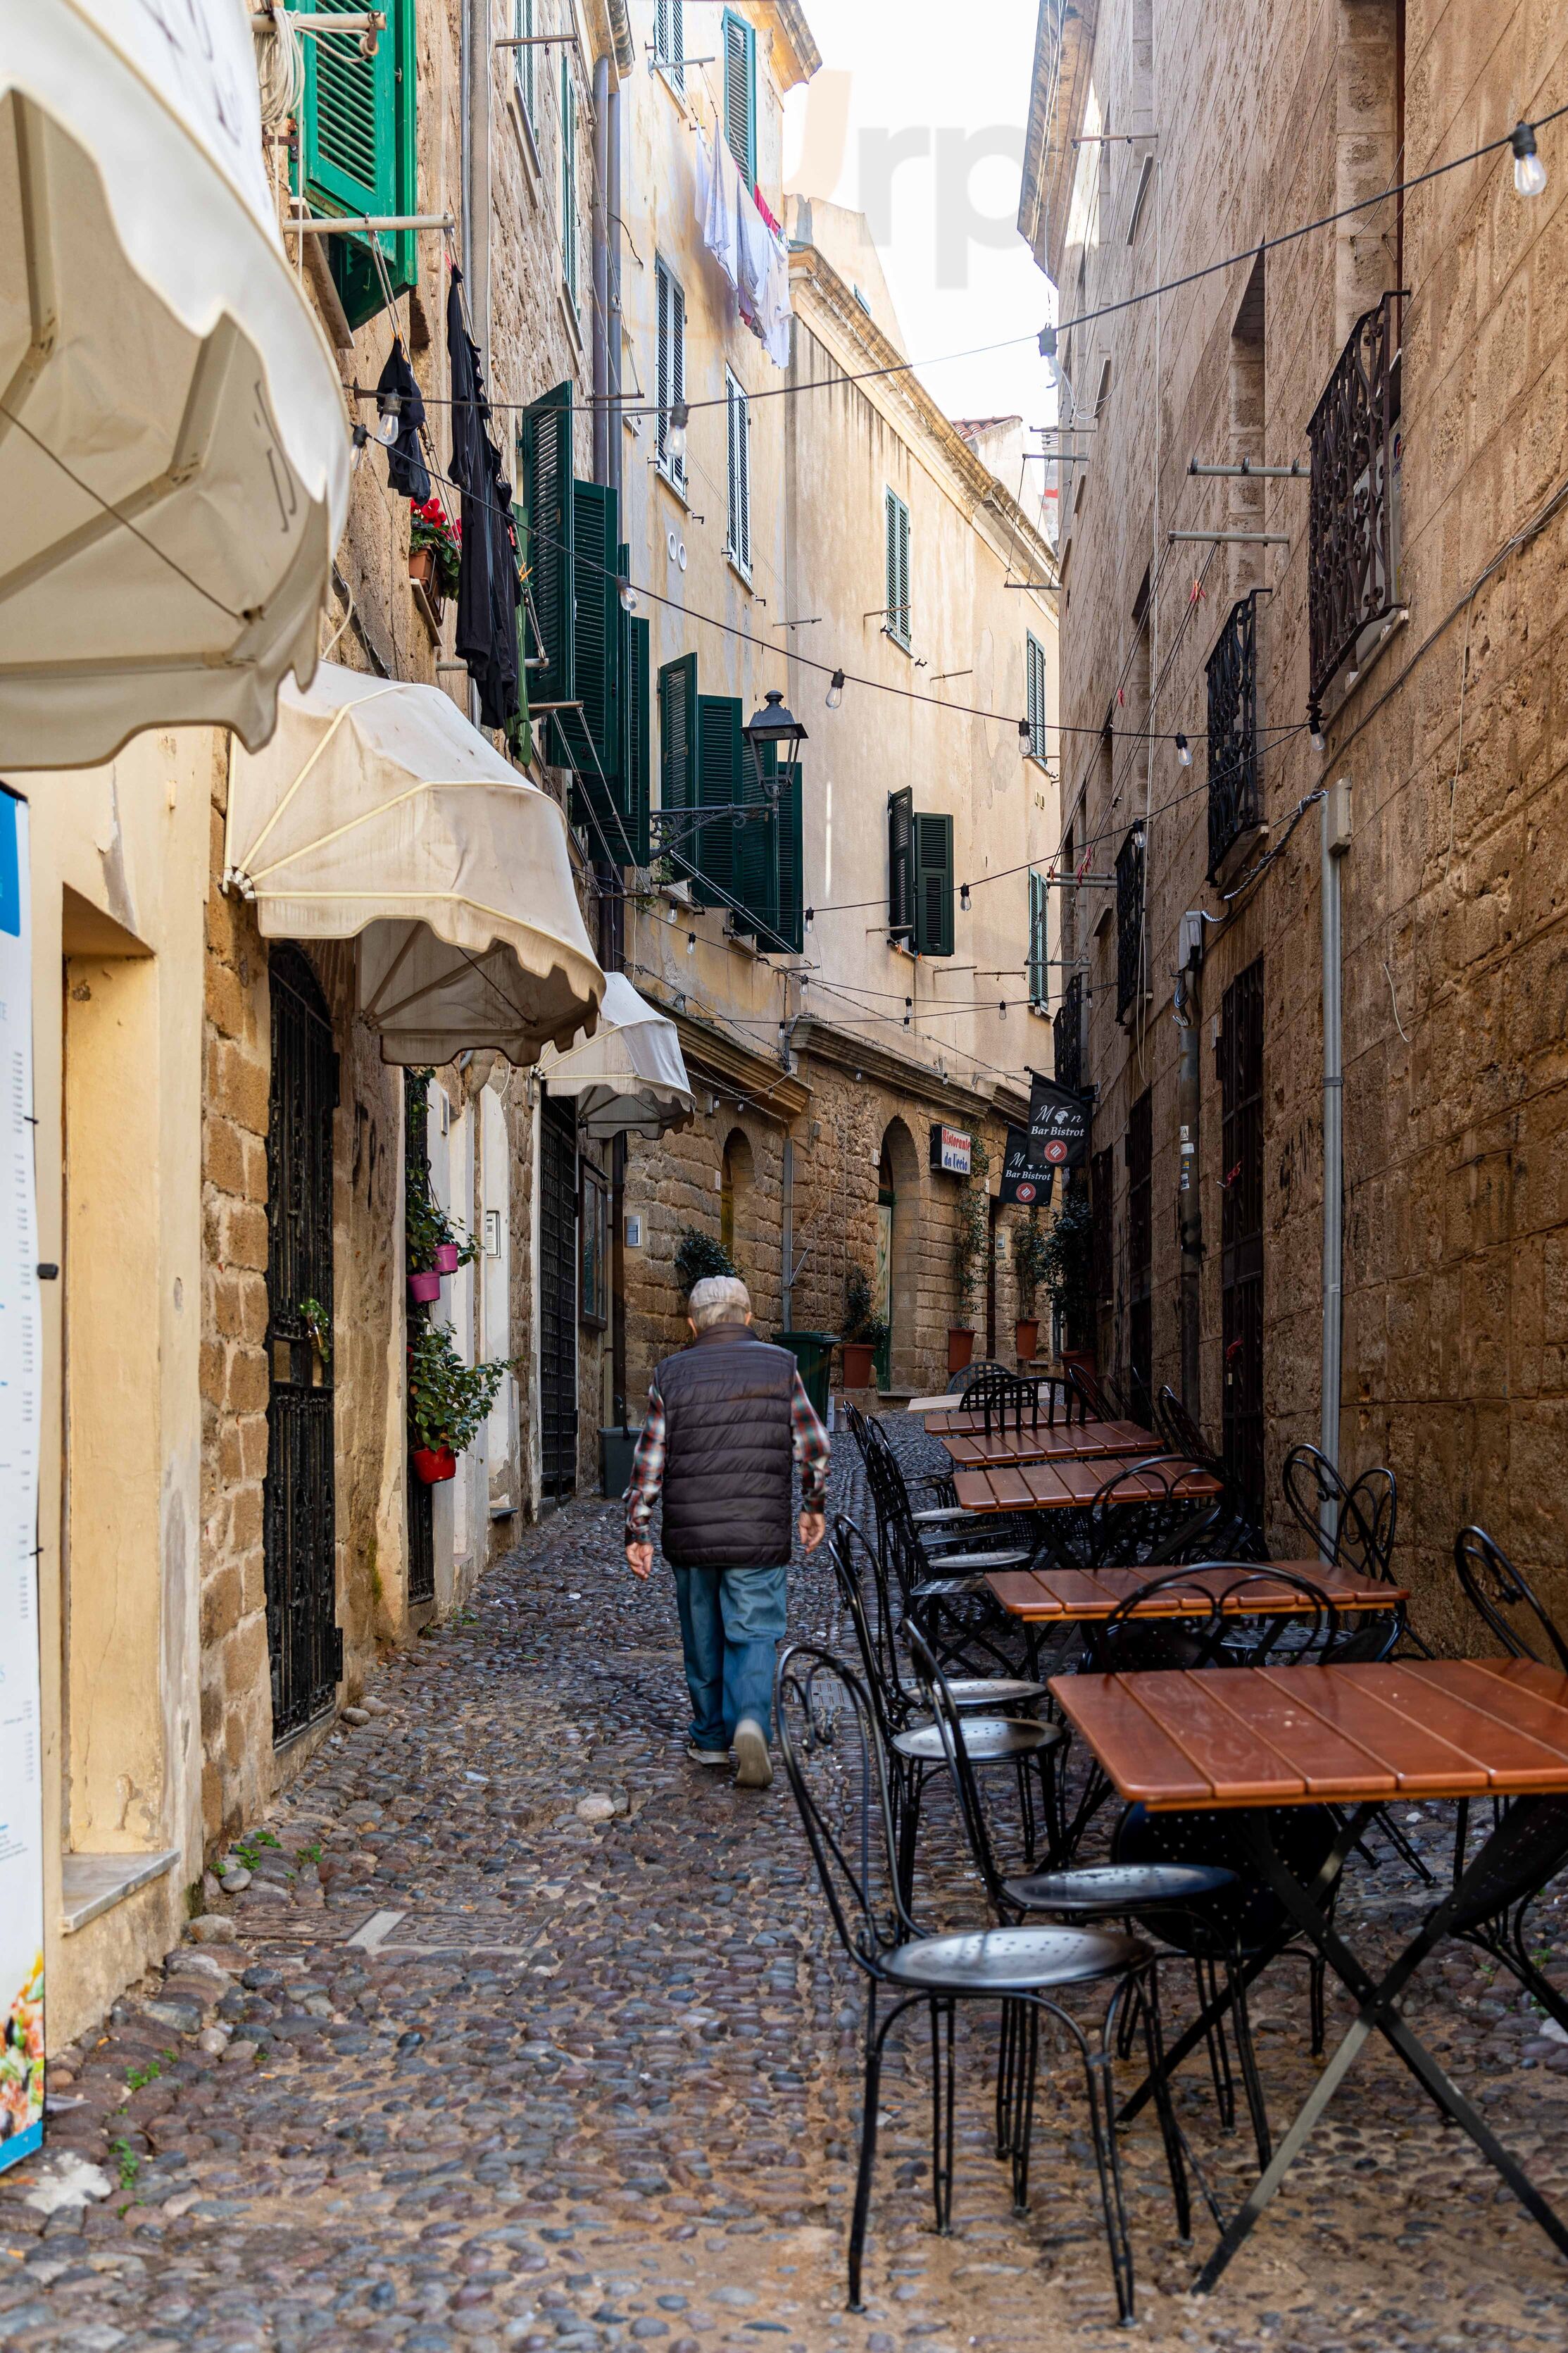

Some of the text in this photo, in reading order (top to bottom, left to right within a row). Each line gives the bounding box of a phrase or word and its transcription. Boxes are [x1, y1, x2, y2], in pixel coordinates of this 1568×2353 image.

[1031, 1126, 1084, 1137] Bar Bistrot
[942, 1129, 971, 1151] Ristorante
[1005, 1170, 1051, 1181] Bar Bistrot
